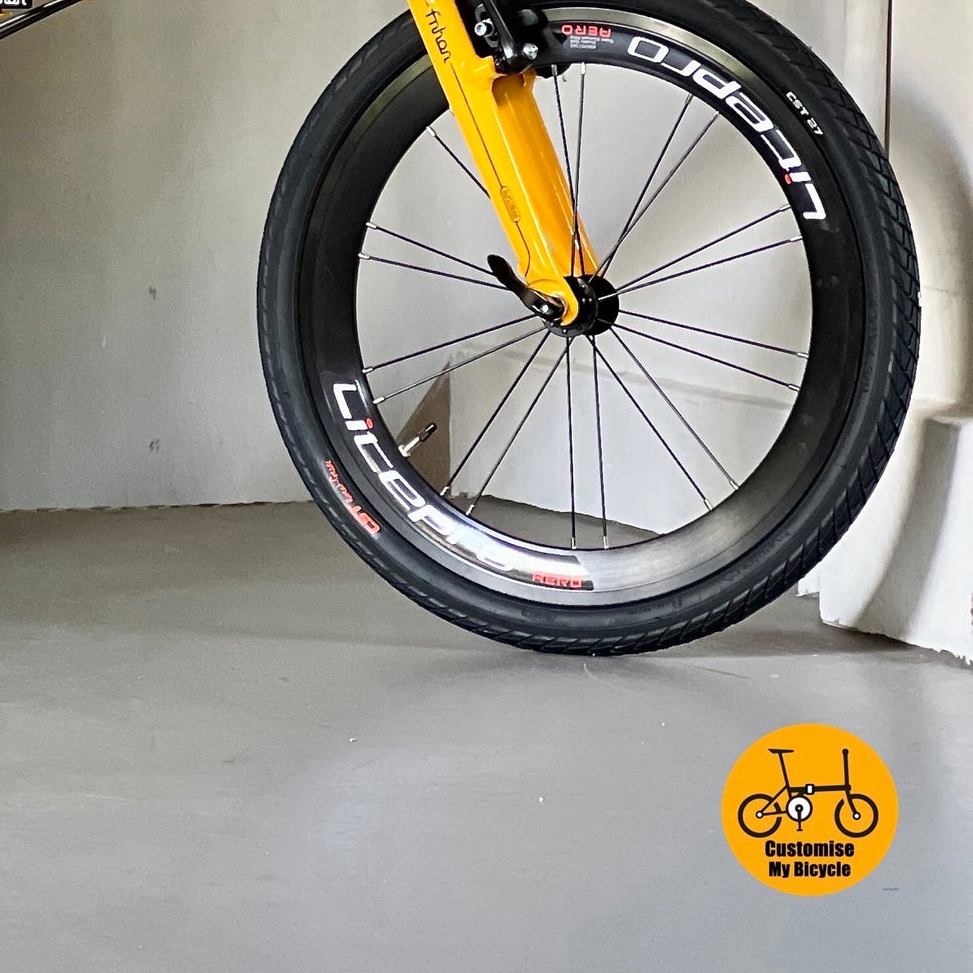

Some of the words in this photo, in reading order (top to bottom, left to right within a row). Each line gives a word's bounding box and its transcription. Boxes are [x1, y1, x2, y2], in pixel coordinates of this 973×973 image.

[425, 8, 452, 64] fnhon
[561, 24, 612, 38] AERO
[627, 36, 826, 220] Litepro
[785, 91, 809, 116] CST
[806, 117, 824, 136] 27
[531, 573, 584, 589] AERO
